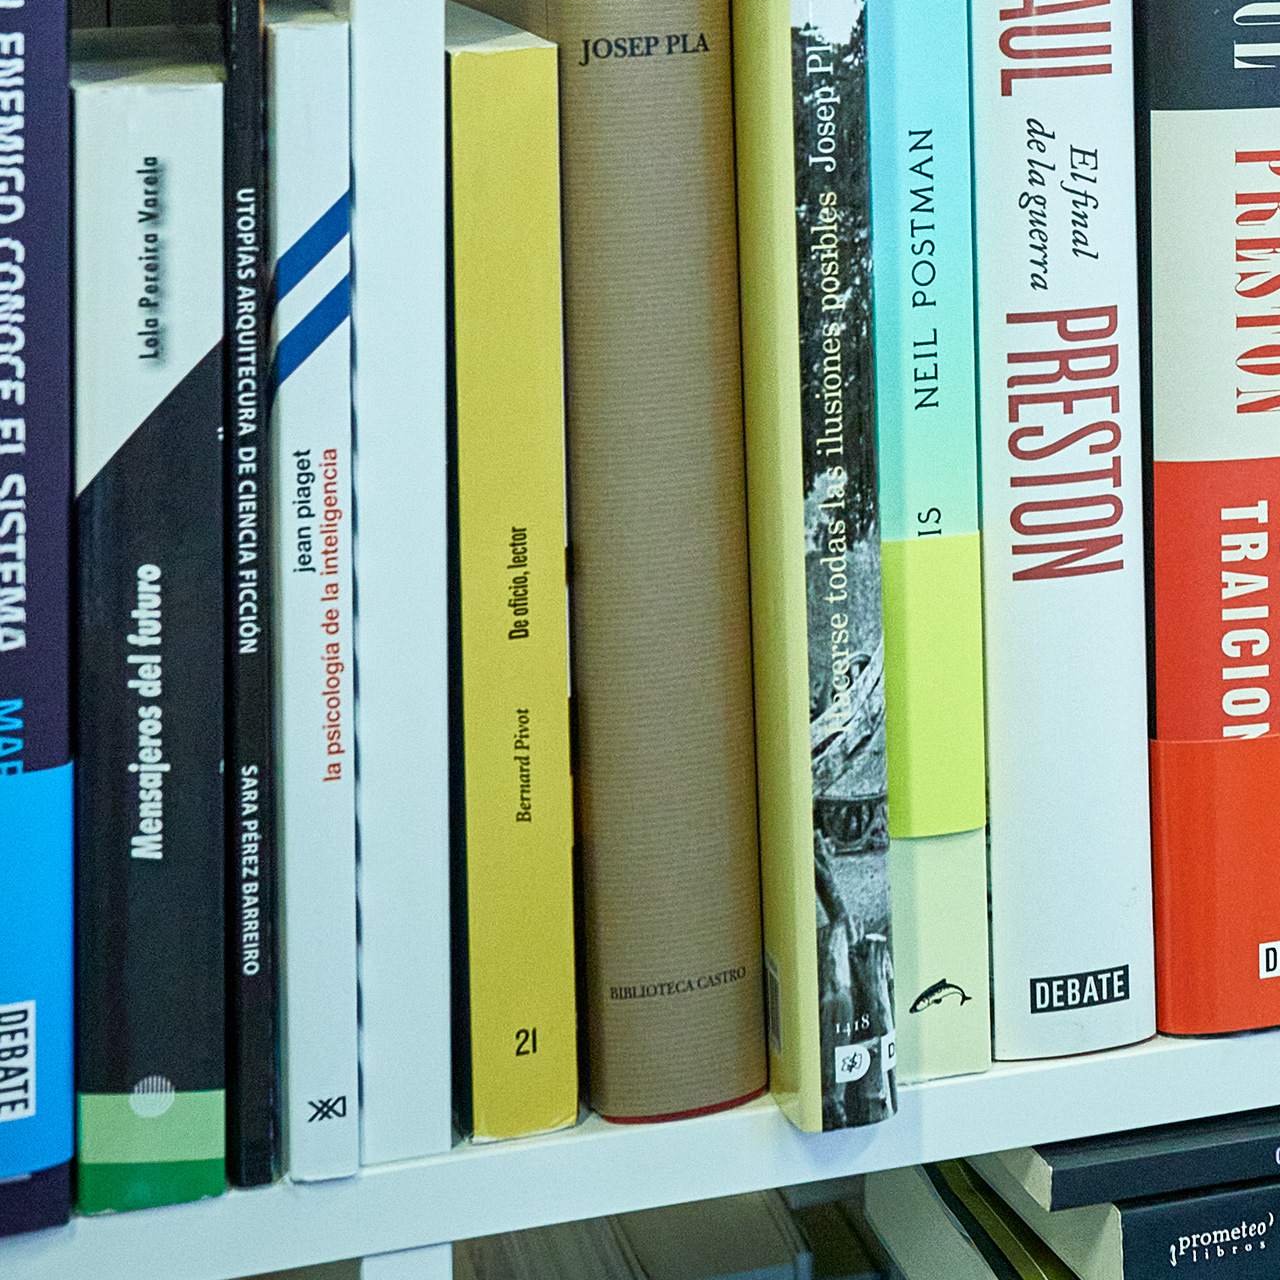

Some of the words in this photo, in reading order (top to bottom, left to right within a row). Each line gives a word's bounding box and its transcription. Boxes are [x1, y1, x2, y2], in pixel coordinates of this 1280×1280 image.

[577, 37, 659, 67] JOSEP
[665, 33, 710, 57] PLA
[1026, 118, 1055, 153] de
[1070, 145, 1098, 183] El
[1027, 159, 1056, 186] la
[237, 188, 259, 279] UTOPÍAS
[909, 129, 936, 308] POSTMAN
[1019, 192, 1048, 290] guerra
[1060, 180, 1098, 259] final
[236, 286, 256, 435] ARQUITECURA
[913, 328, 939, 410] NEIL
[238, 447, 256, 474] DE
[1006, 305, 1124, 581] PRESTON
[293, 449, 315, 518] piaget
[319, 449, 342, 575] inteligencia
[238, 480, 257, 564] CIENCIA
[293, 526, 316, 572] jean
[127, 564, 162, 646] futuro
[239, 570, 260, 653] FICCIÓN
[321, 609, 339, 635] de
[322, 586, 342, 604] la
[127, 655, 162, 697] del
[321, 643, 345, 755] psicología
[514, 708, 531, 749] Pivot
[128, 706, 170, 859] Mensajeros
[241, 765, 258, 816] SARA
[323, 763, 341, 781] la
[515, 750, 531, 822] Bernard
[242, 820, 260, 879] PÉREZ
[242, 881, 259, 976] BARREIRO
[1035, 973, 1126, 1009] DEBATE
[516, 1028, 537, 1056] 21
